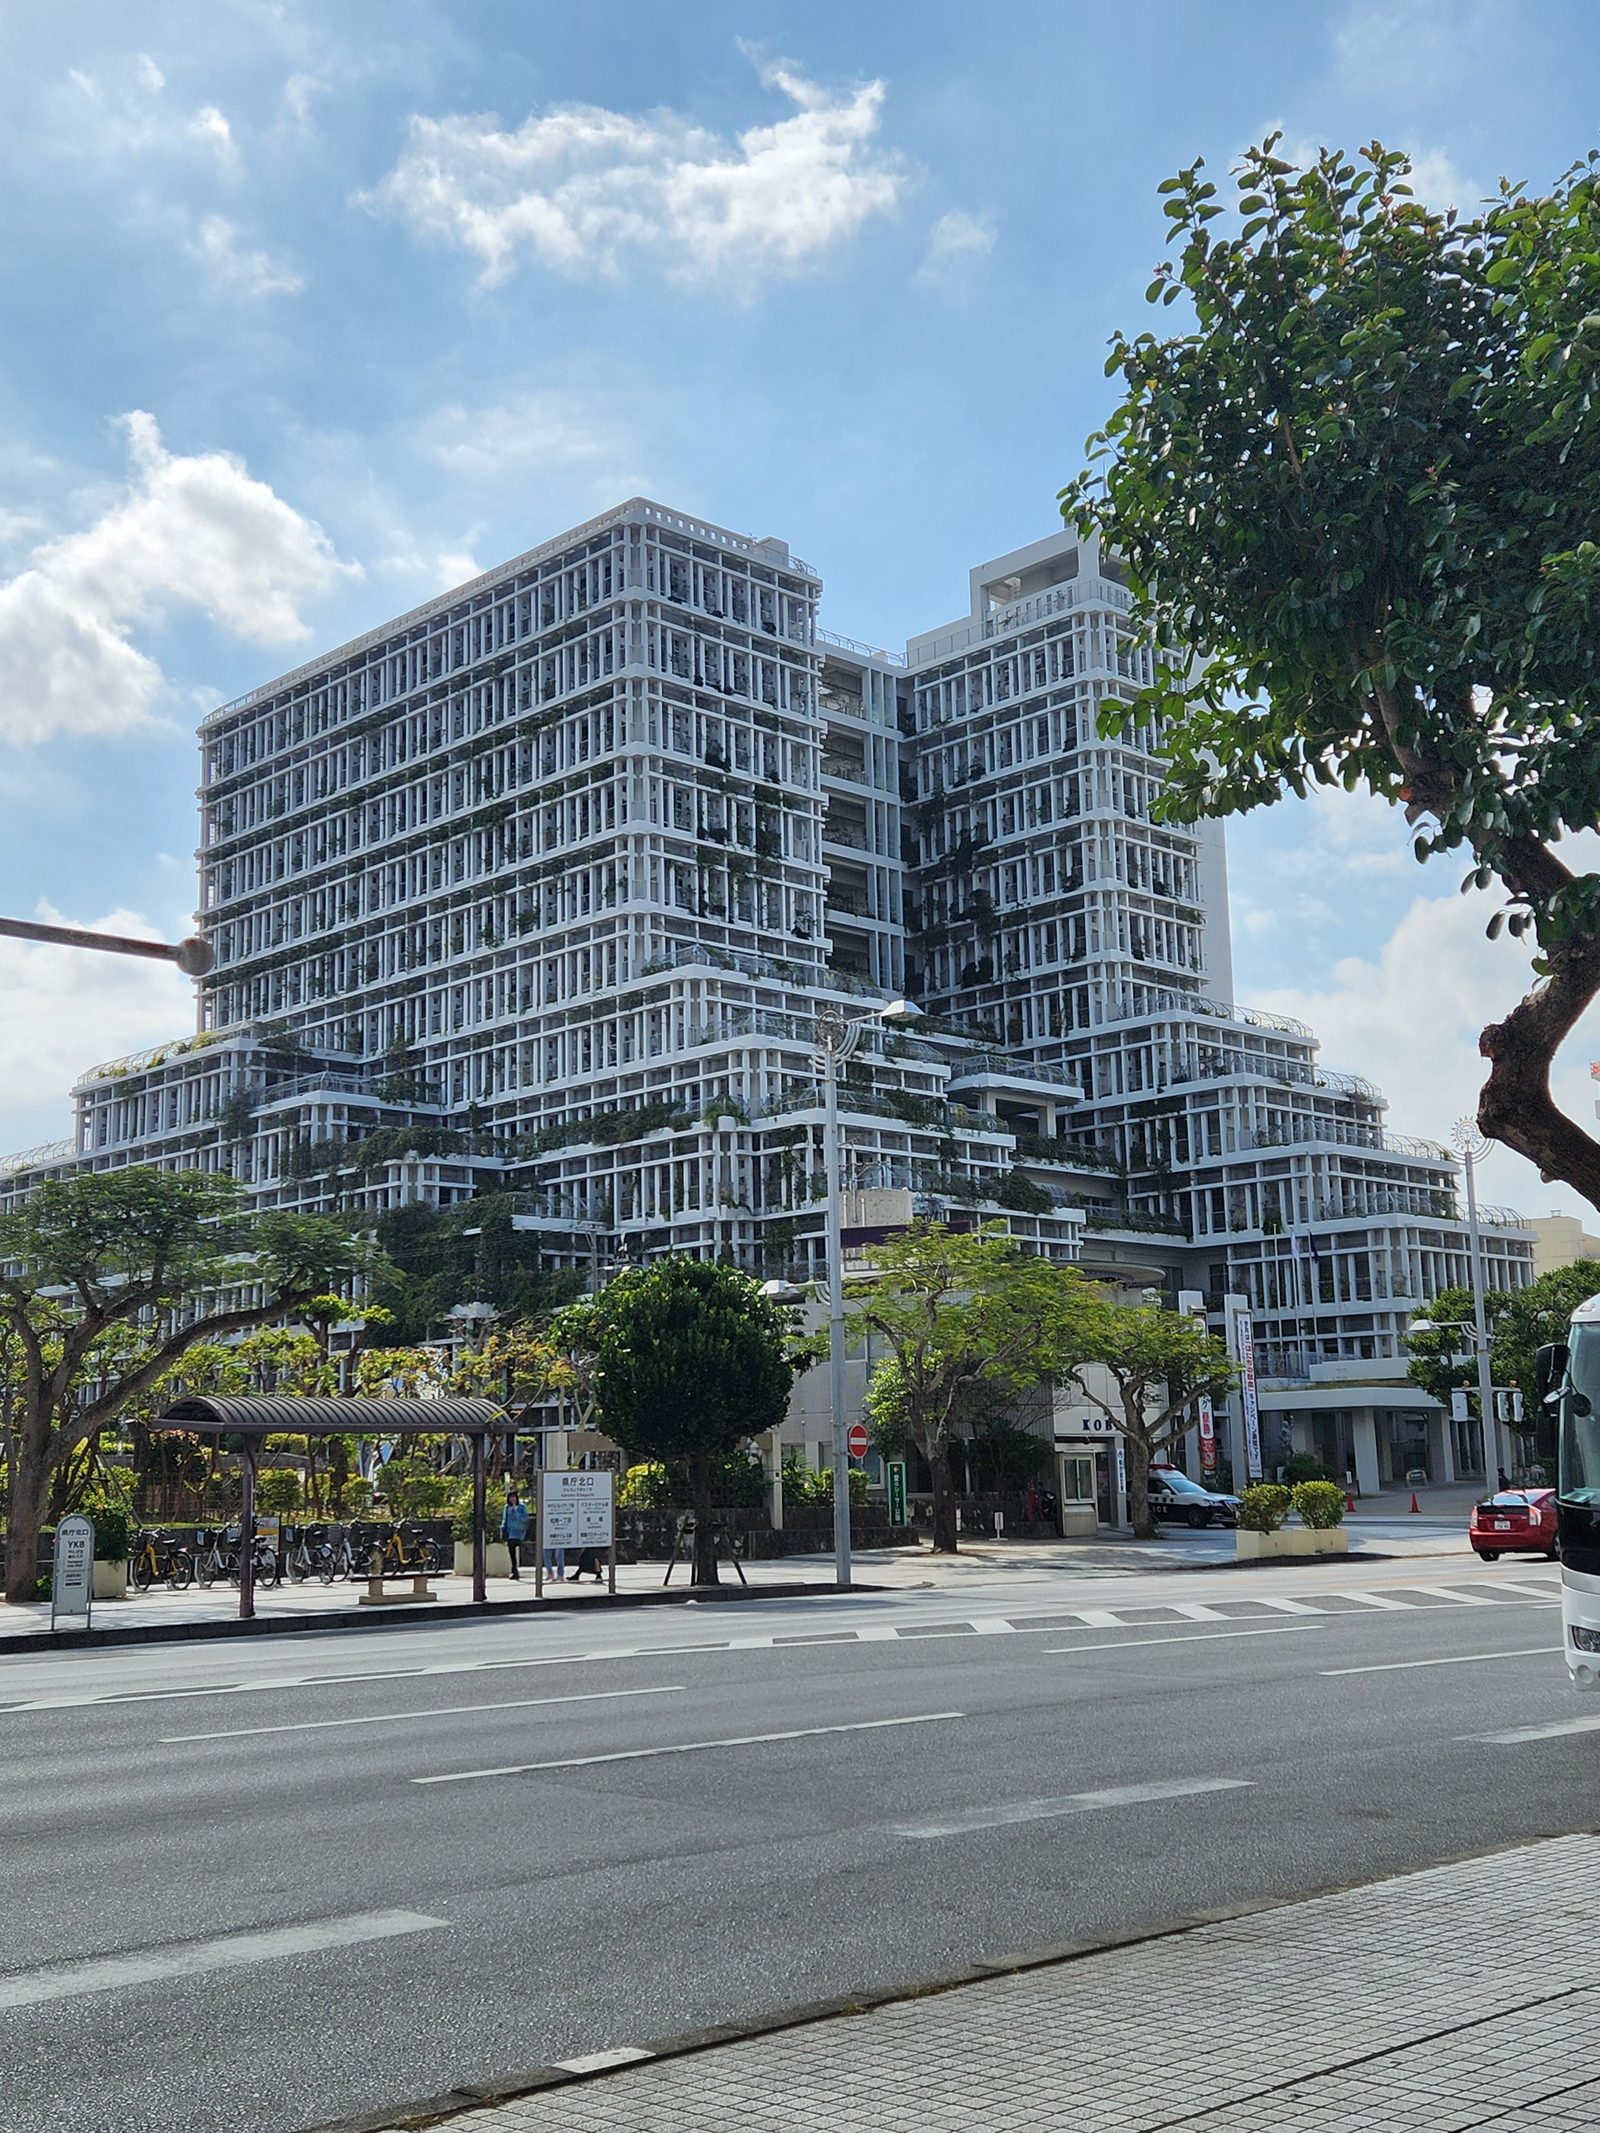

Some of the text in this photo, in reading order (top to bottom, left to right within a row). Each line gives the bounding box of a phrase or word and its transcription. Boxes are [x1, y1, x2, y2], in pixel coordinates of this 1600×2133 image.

[1082, 1418, 1119, 1432] KOB
[562, 1477, 594, 1486] 県庁北口
